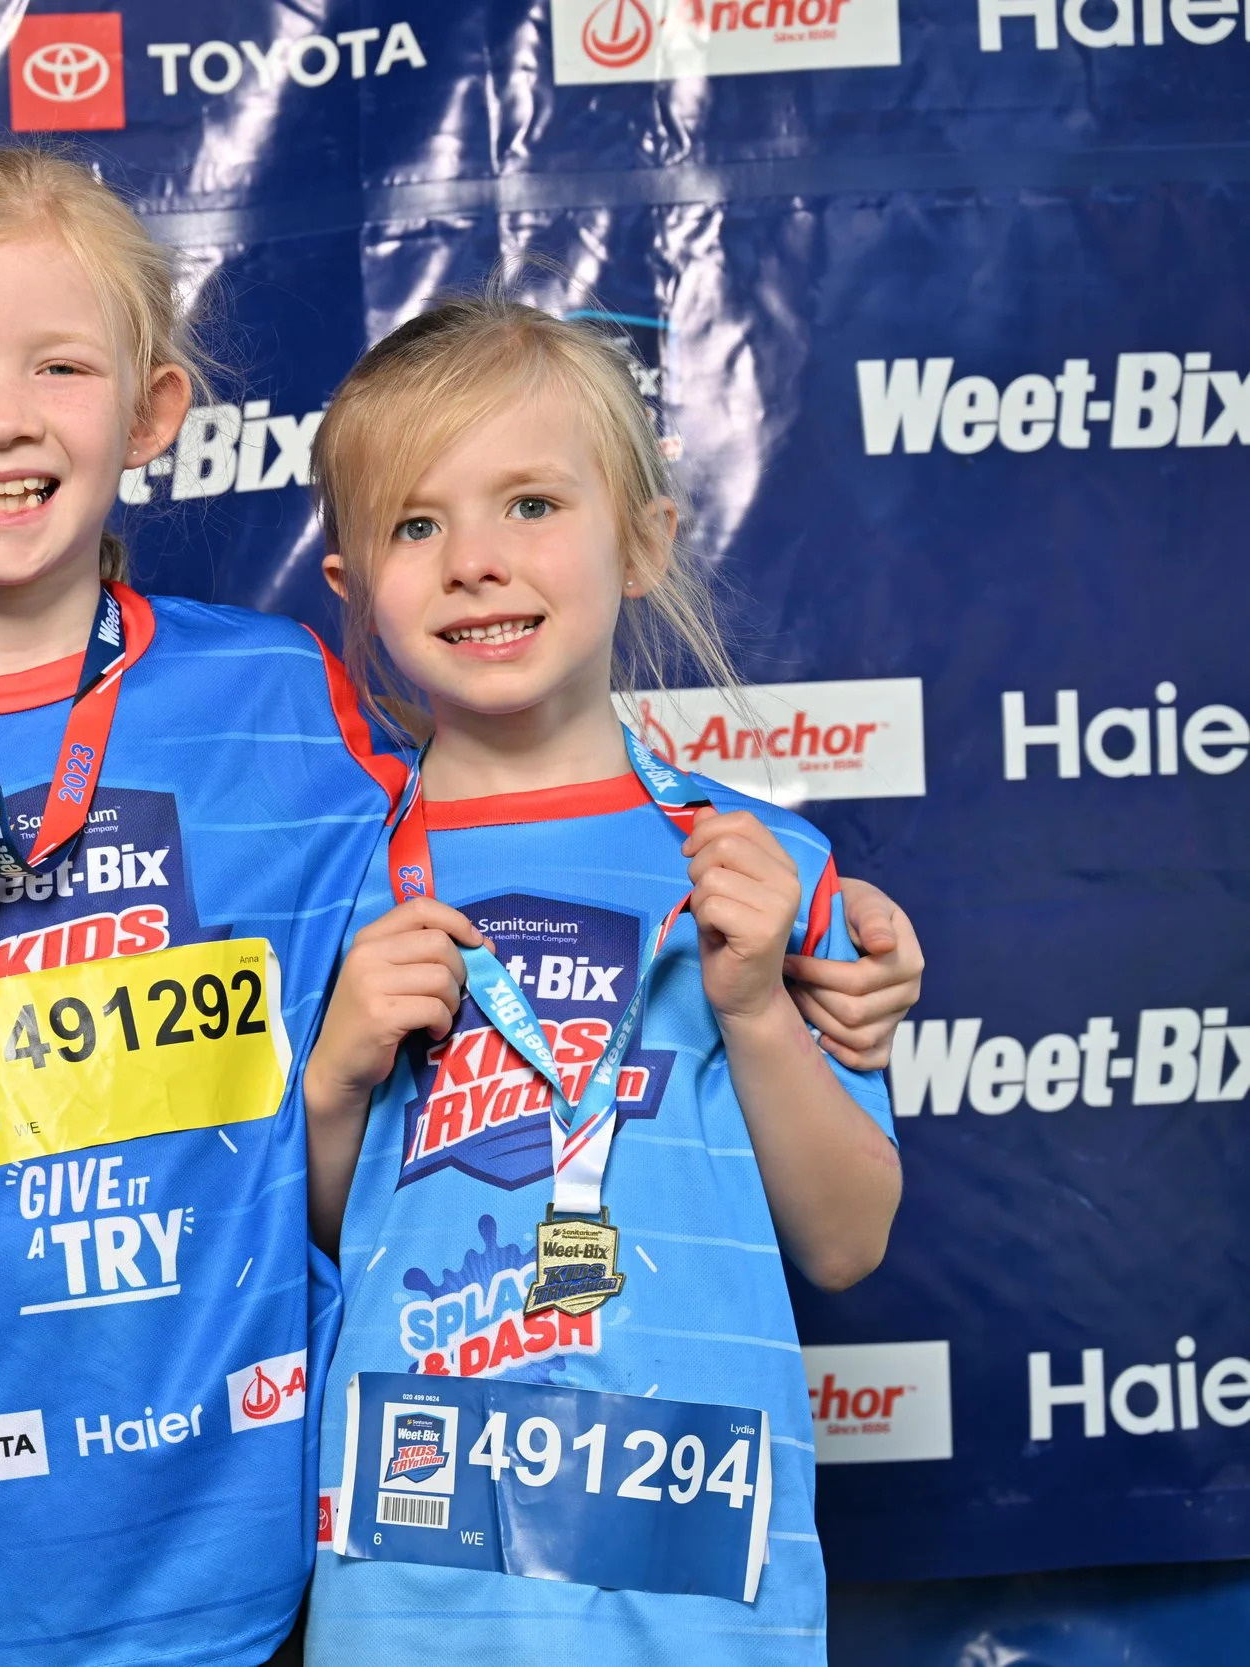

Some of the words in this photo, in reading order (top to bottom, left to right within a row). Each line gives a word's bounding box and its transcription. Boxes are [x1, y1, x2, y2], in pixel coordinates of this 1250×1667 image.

[658, 0, 851, 31] nchor
[978, 0, 1250, 52] Haie
[149, 21, 427, 96] TOYOTA
[684, 711, 877, 762] Anchor
[1002, 681, 1250, 781] Haie
[58, 743, 95, 804] 2023
[399, 865, 425, 903] 23
[478, 917, 578, 933] Sanitarium
[542, 935, 578, 944] Company
[240, 955, 259, 965] Anna
[506, 955, 624, 1002] t-Bix
[5, 969, 267, 1069] 491292
[14, 1121, 41, 1137] WE
[20, 1155, 123, 1220] GIVE
[128, 1176, 150, 1206] IT
[28, 1227, 45, 1259] A
[52, 1208, 184, 1296] TRY
[543, 1241, 608, 1259] Weet-Bix
[544, 1263, 606, 1284] KIDS
[405, 1266, 538, 1351] SPLA
[459, 1310, 593, 1377] DASH
[1029, 1335, 1250, 1441] Haie
[75, 1404, 203, 1457] Haier
[397, 1427, 441, 1442] Weet-Bix
[730, 1423, 755, 1436] Lydia
[392, 1455, 444, 1475] TRYathlon
[398, 1444, 437, 1460] KIDS
[468, 1411, 755, 1509] 491294
[373, 1532, 382, 1545] 6
[460, 1531, 484, 1546] WE
